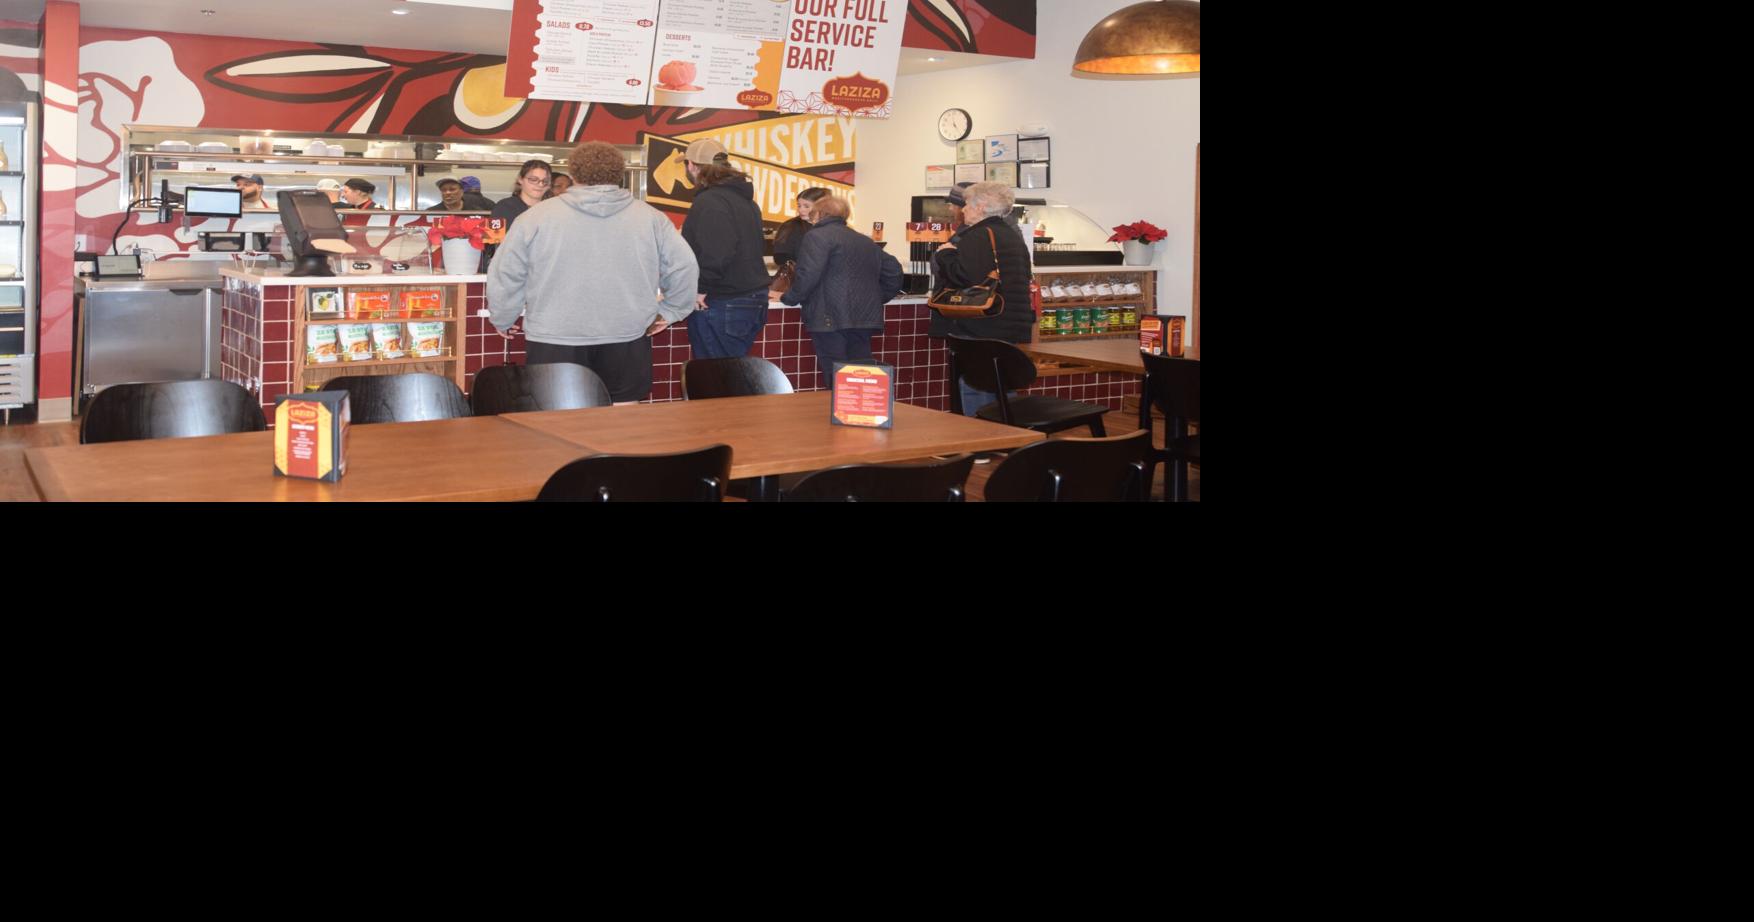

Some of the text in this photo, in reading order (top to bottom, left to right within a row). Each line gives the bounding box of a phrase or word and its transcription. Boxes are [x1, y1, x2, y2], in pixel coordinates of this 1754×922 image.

[795, 0, 838, 18] OUR
[843, 0, 888, 23] FULL
[546, 20, 571, 29] SALADS
[665, 33, 691, 41] DESSERTS
[790, 18, 877, 49] SERVICE
[786, 46, 835, 72] BAR!
[831, 85, 881, 99] LAZIZA
[915, 223, 921, 231] 7
[931, 223, 942, 231] 28
